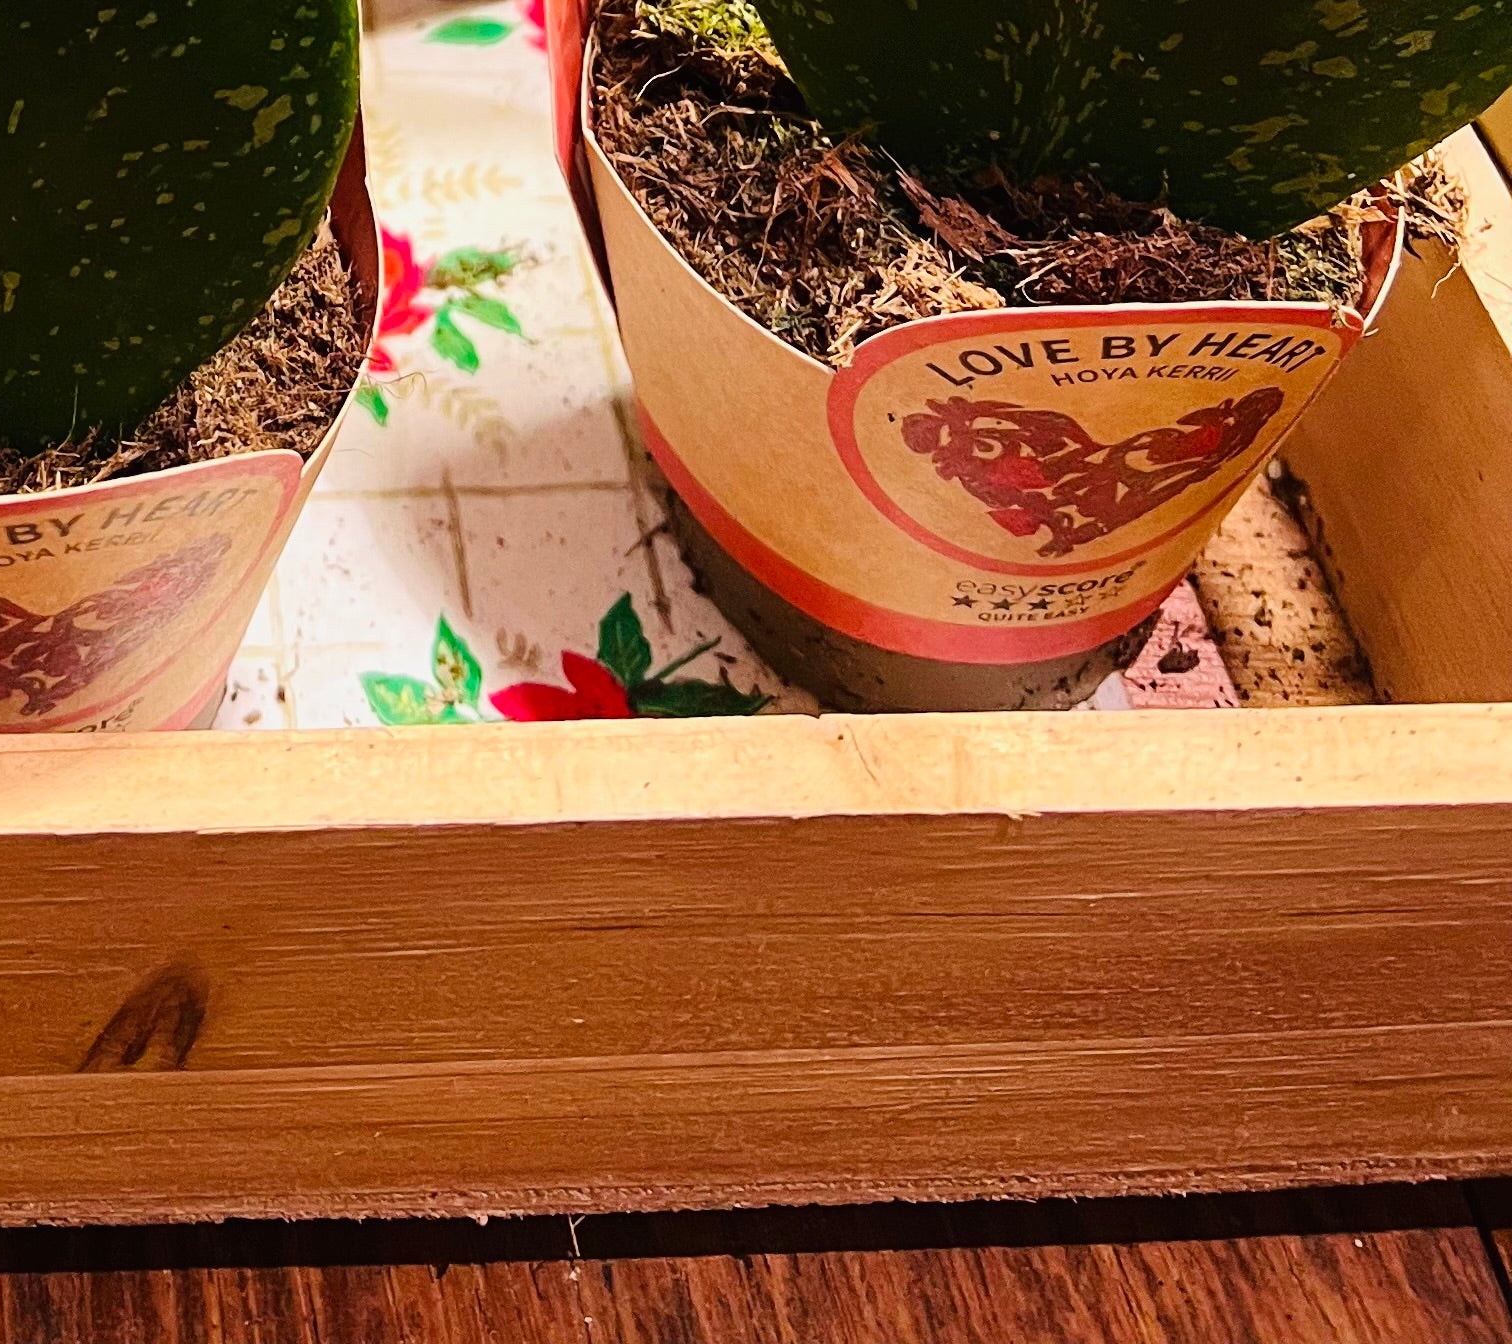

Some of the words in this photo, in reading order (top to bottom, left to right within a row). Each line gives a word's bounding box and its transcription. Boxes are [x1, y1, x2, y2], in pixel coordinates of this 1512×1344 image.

[926, 339, 1080, 388] LOVE
[1101, 333, 1182, 360] BY
[1188, 332, 1330, 374] HEART
[1051, 366, 1137, 387] HOYA
[1146, 364, 1239, 383] KERRII
[6, 517, 86, 546] BY
[101, 488, 258, 530] HEART
[978, 612, 1037, 623] QUITE
[1043, 606, 1089, 620] EASY
